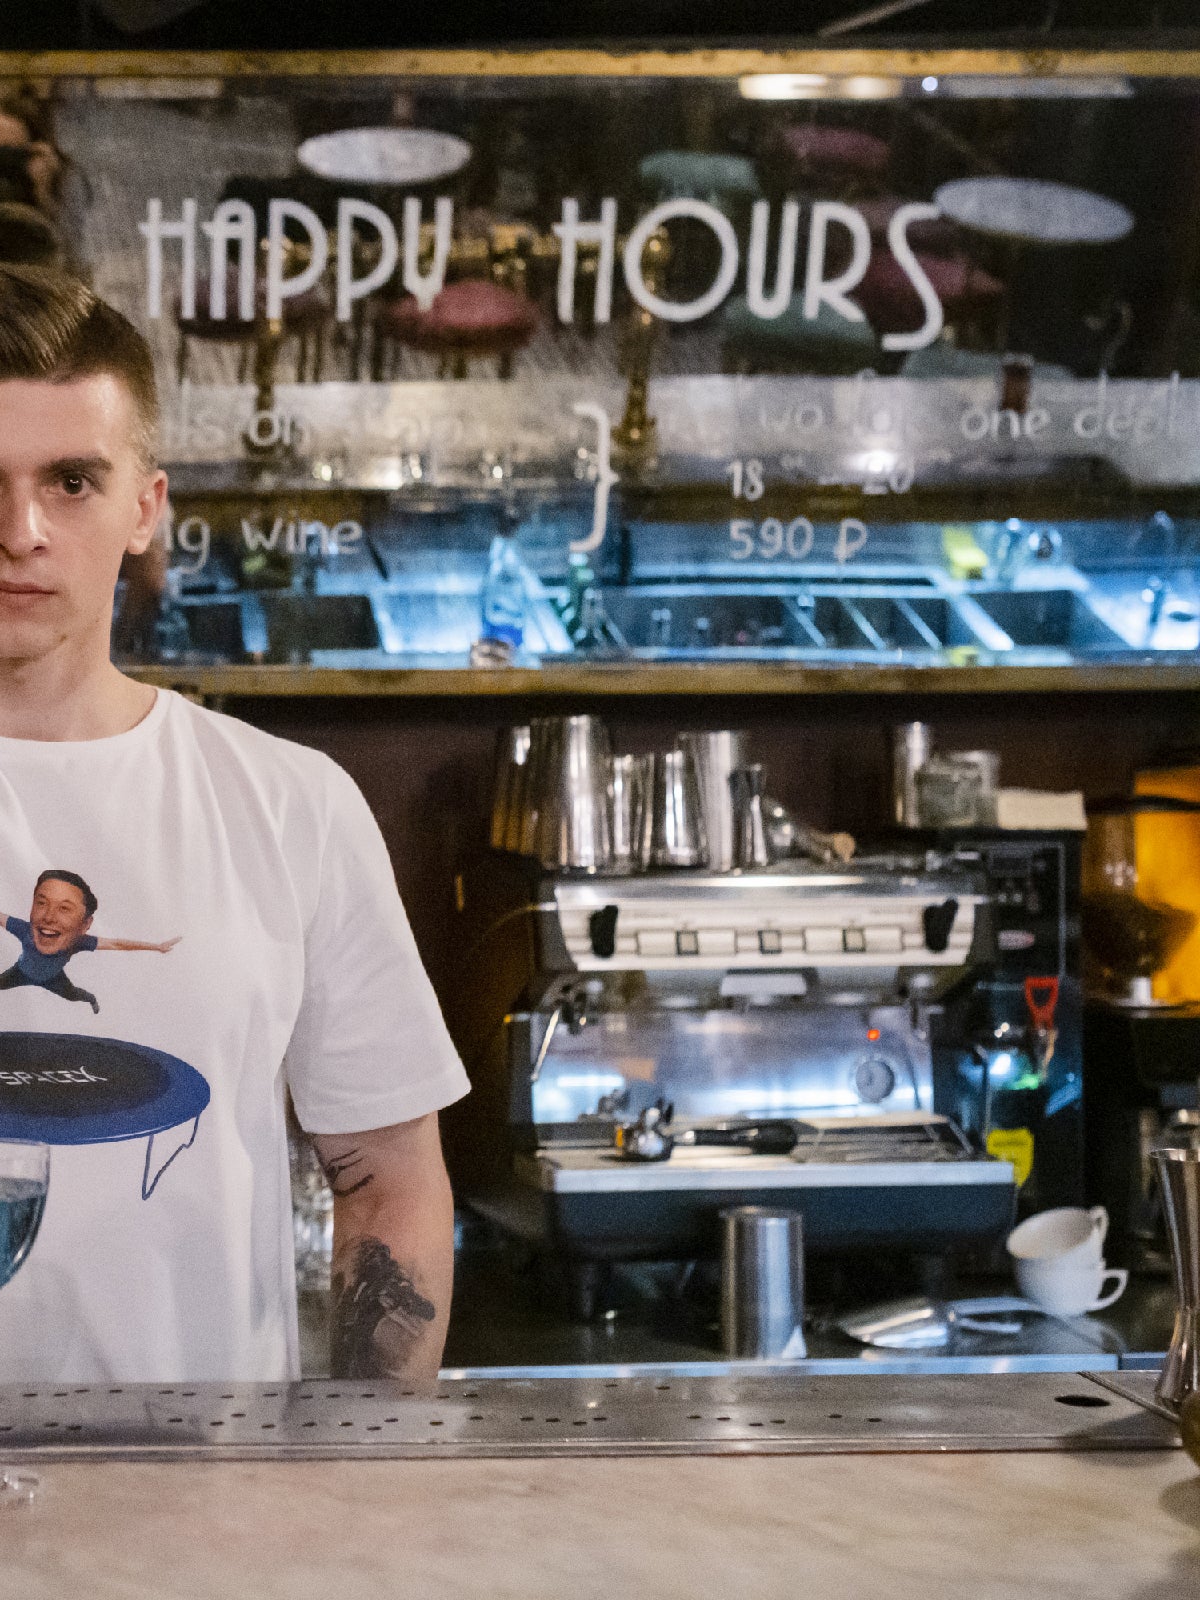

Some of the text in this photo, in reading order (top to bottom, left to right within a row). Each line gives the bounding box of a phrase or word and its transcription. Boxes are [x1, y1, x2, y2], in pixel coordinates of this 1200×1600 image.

[138, 197, 943, 352] HAPPY HOURS
[959, 407, 1051, 443] one
[240, 510, 364, 556] wine
[729, 517, 815, 560] 590
